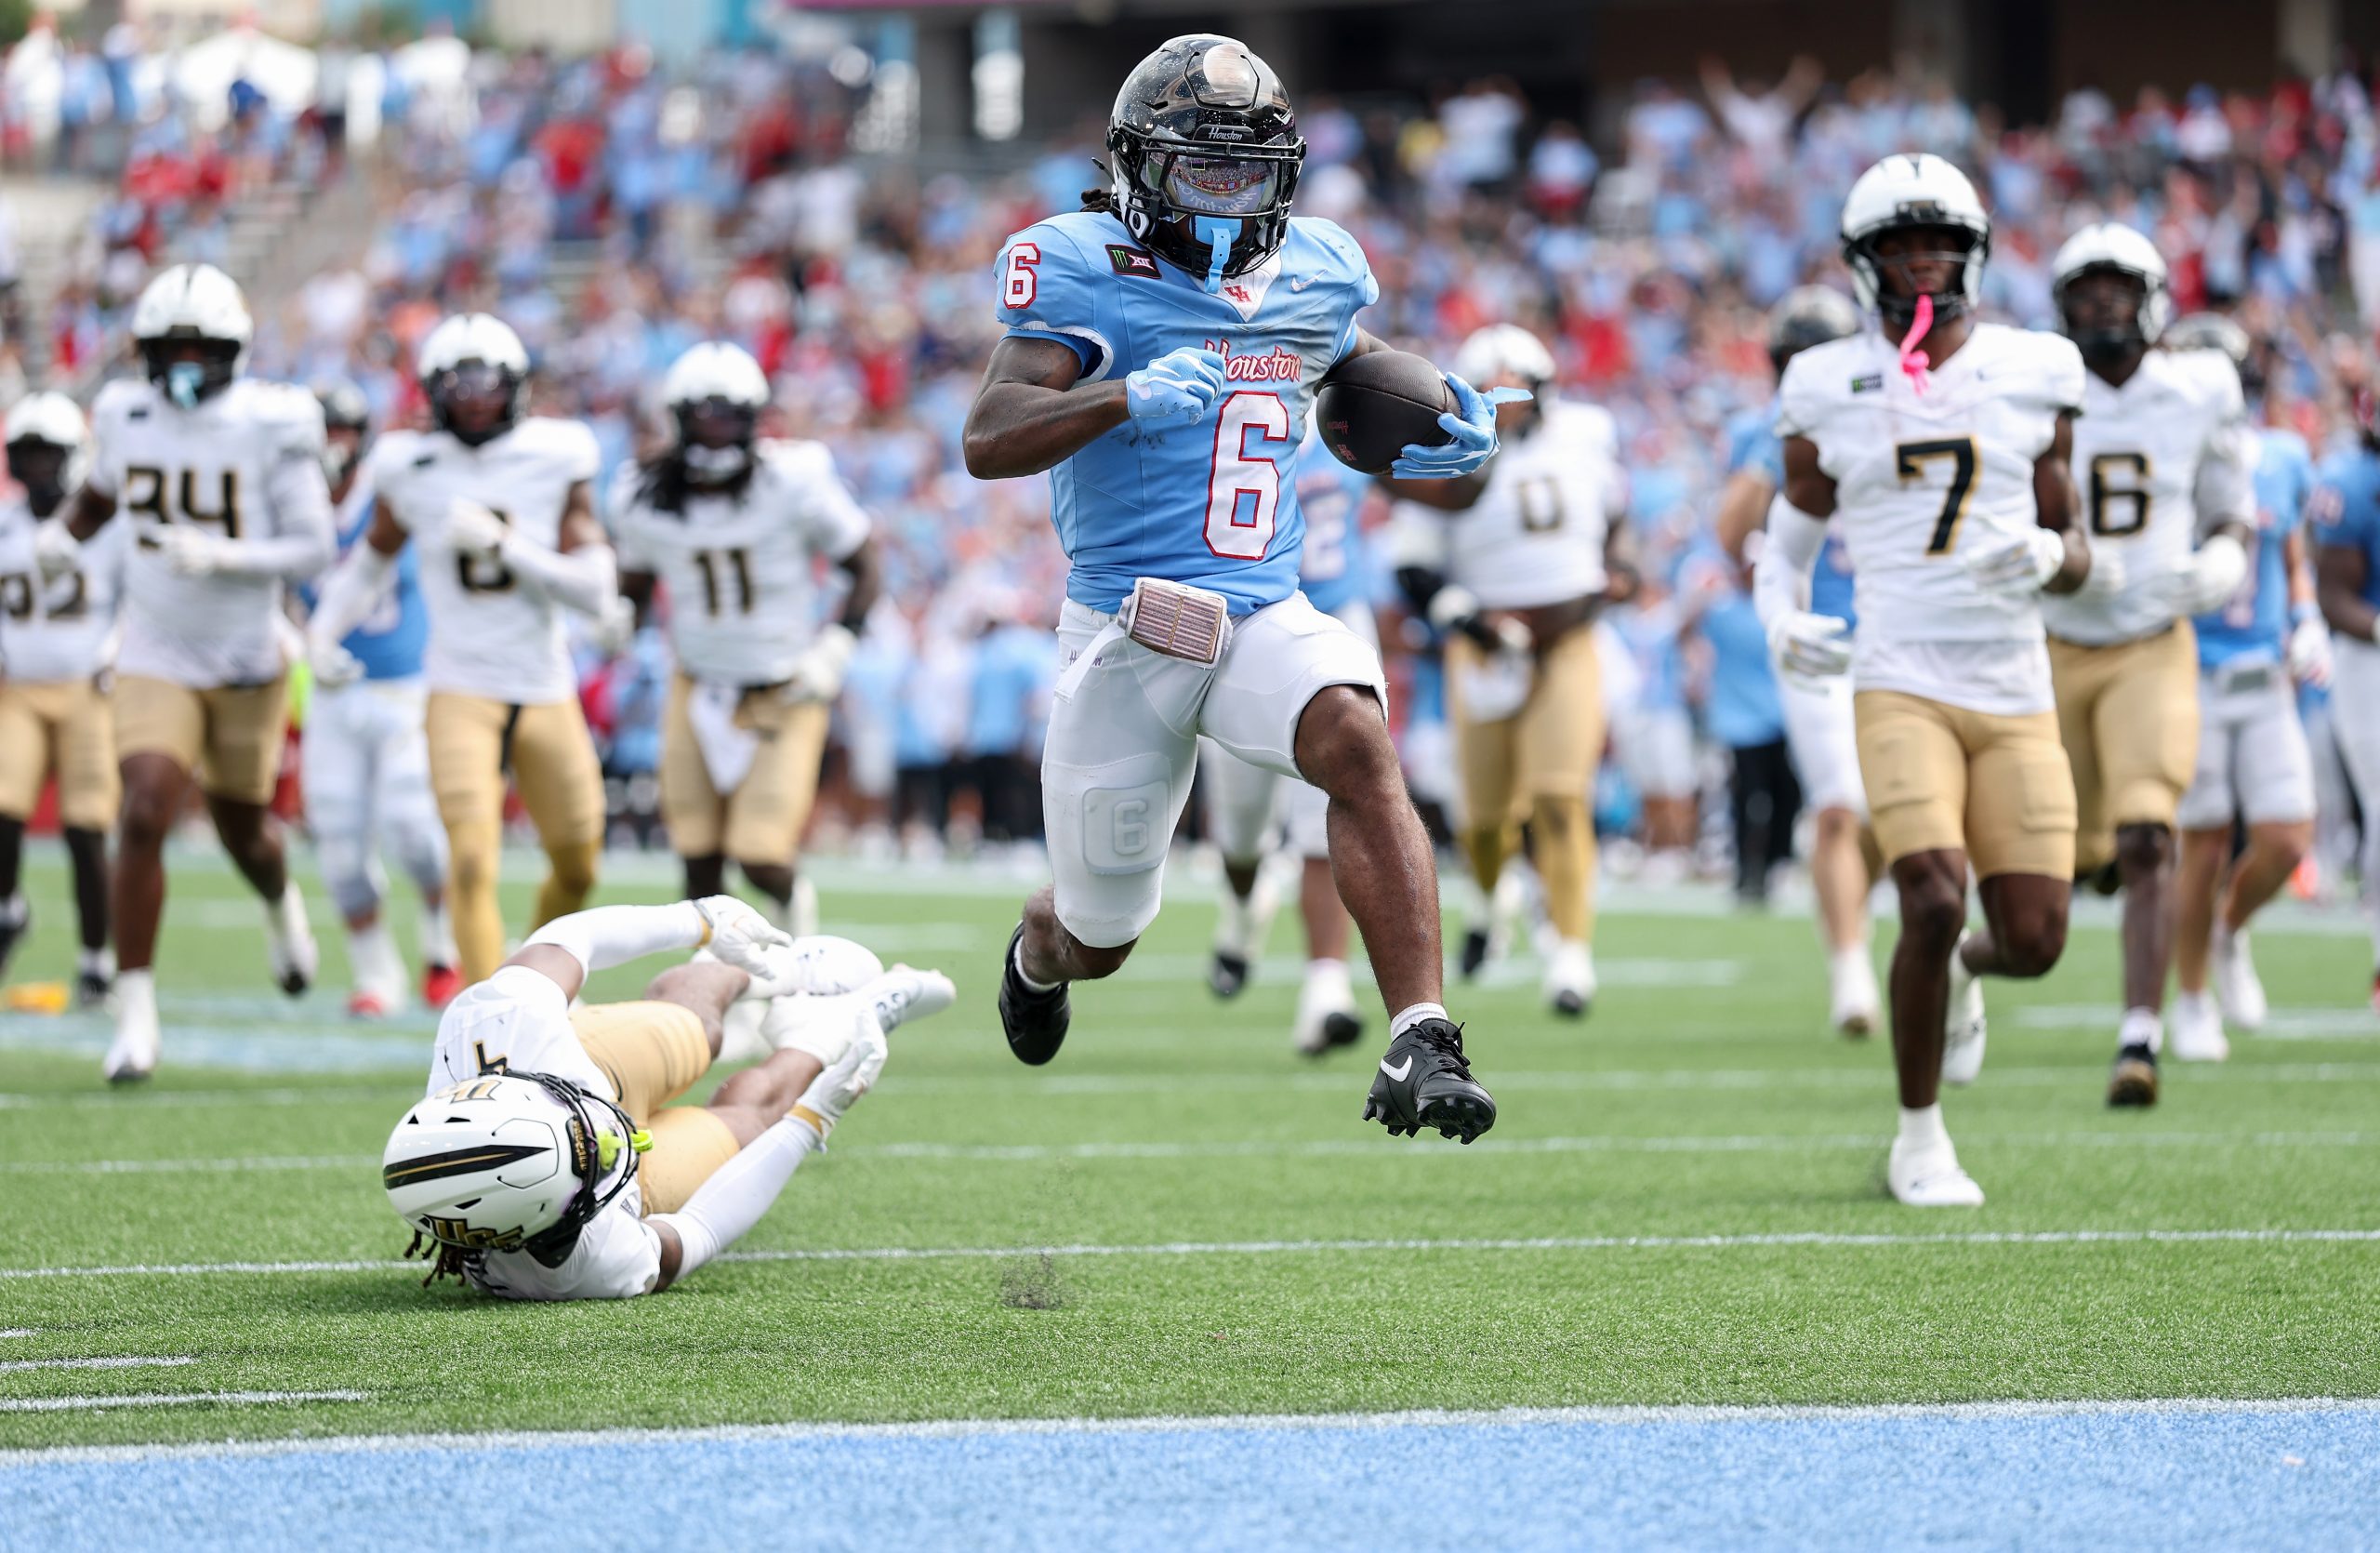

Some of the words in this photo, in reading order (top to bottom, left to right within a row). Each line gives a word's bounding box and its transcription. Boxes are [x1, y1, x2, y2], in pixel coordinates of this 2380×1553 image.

[1208, 126, 1243, 141] Houston
[1003, 242, 1041, 310] 6
[1202, 390, 1289, 561] 6
[1897, 433, 1982, 557] 7
[2090, 451, 2153, 538] 6
[693, 546, 755, 619] 11
[1112, 799, 1149, 856] 6
